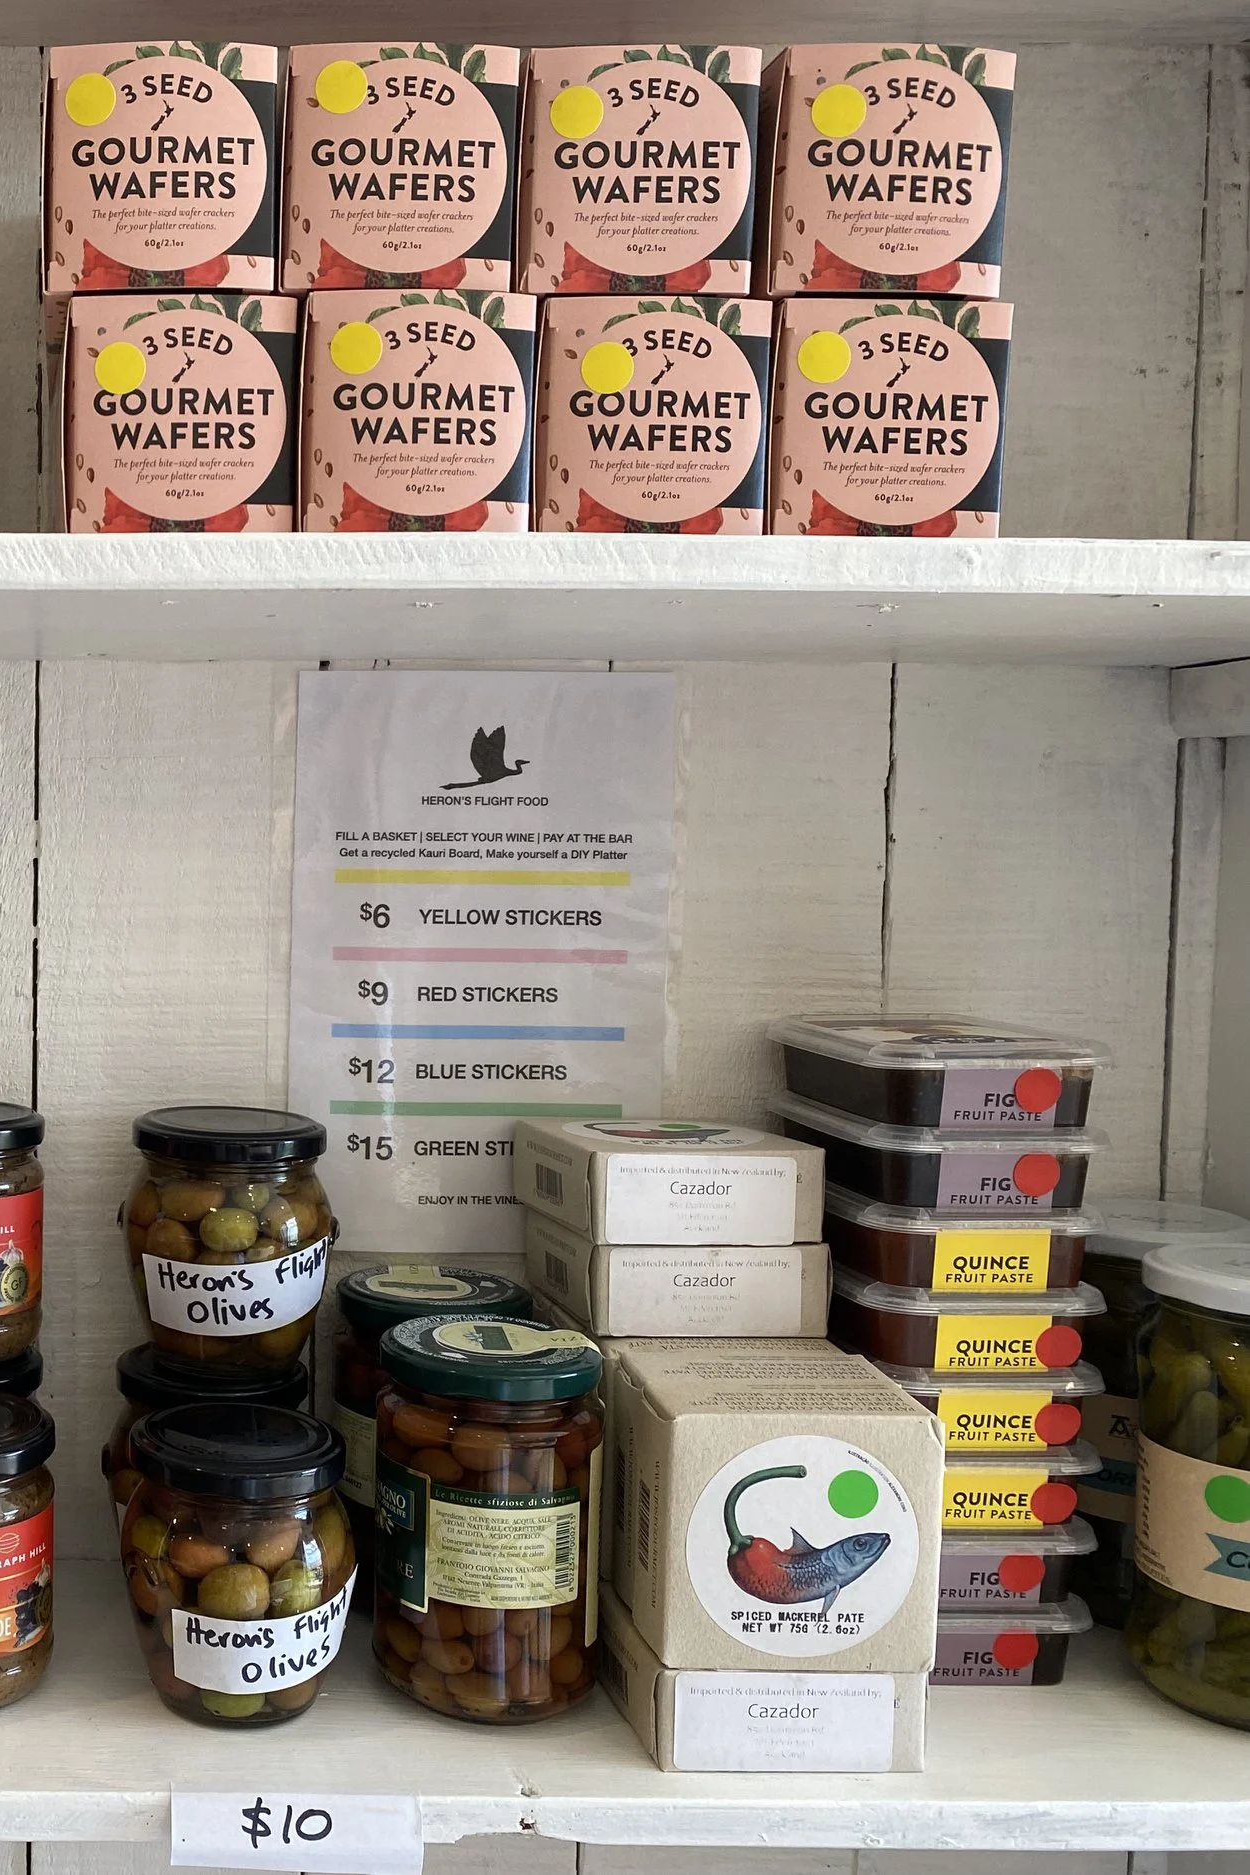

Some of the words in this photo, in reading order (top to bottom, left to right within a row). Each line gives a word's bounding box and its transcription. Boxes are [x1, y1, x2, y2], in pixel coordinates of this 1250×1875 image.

[121, 84, 137, 103] 3
[142, 73, 212, 103] SEED
[385, 76, 455, 106] SEED
[608, 88, 623, 107] 3
[630, 78, 699, 107] SEED
[865, 85, 880, 105] 3
[888, 77, 956, 108] SEED
[72, 137, 255, 167] GOURMET
[312, 139, 496, 169] GOURMET
[554, 141, 741, 169] GOURMET
[808, 140, 992, 172] GOURMET
[89, 171, 236, 200] WAFERS
[328, 173, 475, 202] WAFERS
[572, 176, 720, 204] WAFERS
[826, 175, 972, 205] WAFERS
[92, 210, 106, 219] The
[108, 208, 135, 221] perfect
[179, 207, 201, 220] wafer
[204, 207, 234, 217] crackers
[114, 222, 127, 234] for
[128, 224, 147, 233] your
[150, 221, 177, 233] platter
[164, 327, 234, 355] SEED
[407, 322, 476, 351] SEED
[644, 329, 712, 359] SEED
[880, 332, 949, 362] SEED
[94, 388, 274, 416] GOURMET
[333, 383, 515, 413] GOURMET
[570, 390, 750, 419] GOURMET
[804, 392, 988, 423] GOURMET
[111, 423, 256, 450] WAFERS
[351, 418, 496, 446] WAFERS
[588, 425, 732, 452] WAFERS
[823, 427, 968, 456] WAFERS
[422, 796, 472, 806] HERON'S
[475, 797, 514, 806] FLIGHT
[517, 797, 548, 806] FOOD
[336, 832, 358, 841] FILL
[362, 832, 369, 841] A
[373, 832, 417, 842] BASKET
[426, 832, 468, 842] SELECT
[471, 833, 502, 842] YOUR
[506, 833, 534, 842] WINE
[543, 834, 564, 843] PAY
[567, 834, 580, 843] AT
[584, 834, 605, 843] THE
[609, 834, 632, 844] BAR
[340, 848, 358, 858] Get
[371, 848, 415, 860] recycled
[419, 849, 445, 858] Kauri
[449, 849, 483, 860] Board,
[486, 850, 514, 859] Make
[517, 850, 558, 862] yourself
[571, 850, 588, 860] DIY
[593, 851, 627, 860] Platter
[360, 902, 390, 928] $6
[419, 909, 500, 926] YELLOW
[505, 910, 602, 926] STICKERS
[358, 980, 388, 1005] $9
[418, 987, 456, 1002] RED
[462, 987, 558, 1003] STICKERS
[348, 1057, 395, 1083] $12
[416, 1064, 466, 1080] BLUE
[471, 1064, 567, 1081] STICKERS
[984, 1093, 1016, 1107] FIG
[954, 1110, 996, 1121] FRUIT
[1000, 1111, 1042, 1121] PASTE
[347, 1134, 392, 1160] $15
[414, 1141, 479, 1156] GREEN
[418, 1196, 452, 1205] ENJOY
[457, 1196, 468, 1204] IN
[471, 1196, 492, 1204] THE
[669, 1181, 732, 1196] Cazador
[158, 1262, 254, 1291] Heron's
[953, 1255, 1029, 1273] QUINCE
[673, 1273, 736, 1287] Cazador
[945, 1273, 988, 1283] FRUIT
[992, 1273, 1033, 1284] PASTE
[187, 1298, 274, 1325] Olives
[956, 1339, 1032, 1356] QUINCE
[475, 1565, 513, 1573] GIOVANNI
[731, 1612, 772, 1620] SPICED
[778, 1612, 830, 1622] MACKEREL
[838, 1614, 864, 1622] PATE
[186, 1617, 274, 1649] Heron's
[242, 1634, 330, 1683] Olives
[241, 1797, 332, 1848] $10
